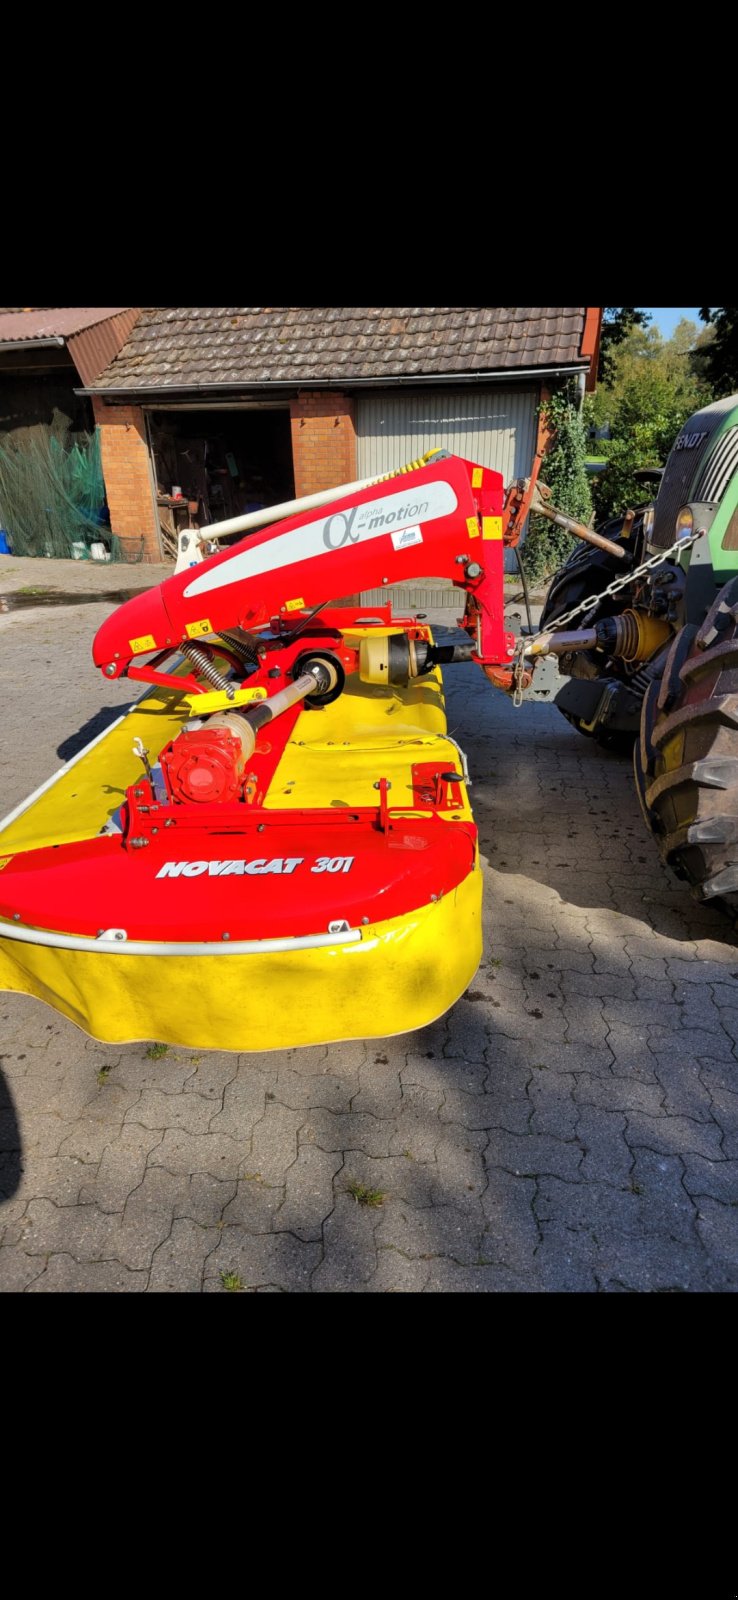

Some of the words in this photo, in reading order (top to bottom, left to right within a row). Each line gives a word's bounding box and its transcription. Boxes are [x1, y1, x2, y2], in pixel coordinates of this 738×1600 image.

[674, 432, 708, 450] FENDT
[359, 507, 383, 520] alpha
[155, 858, 304, 878] NOVACAT
[310, 856, 355, 873] 301
